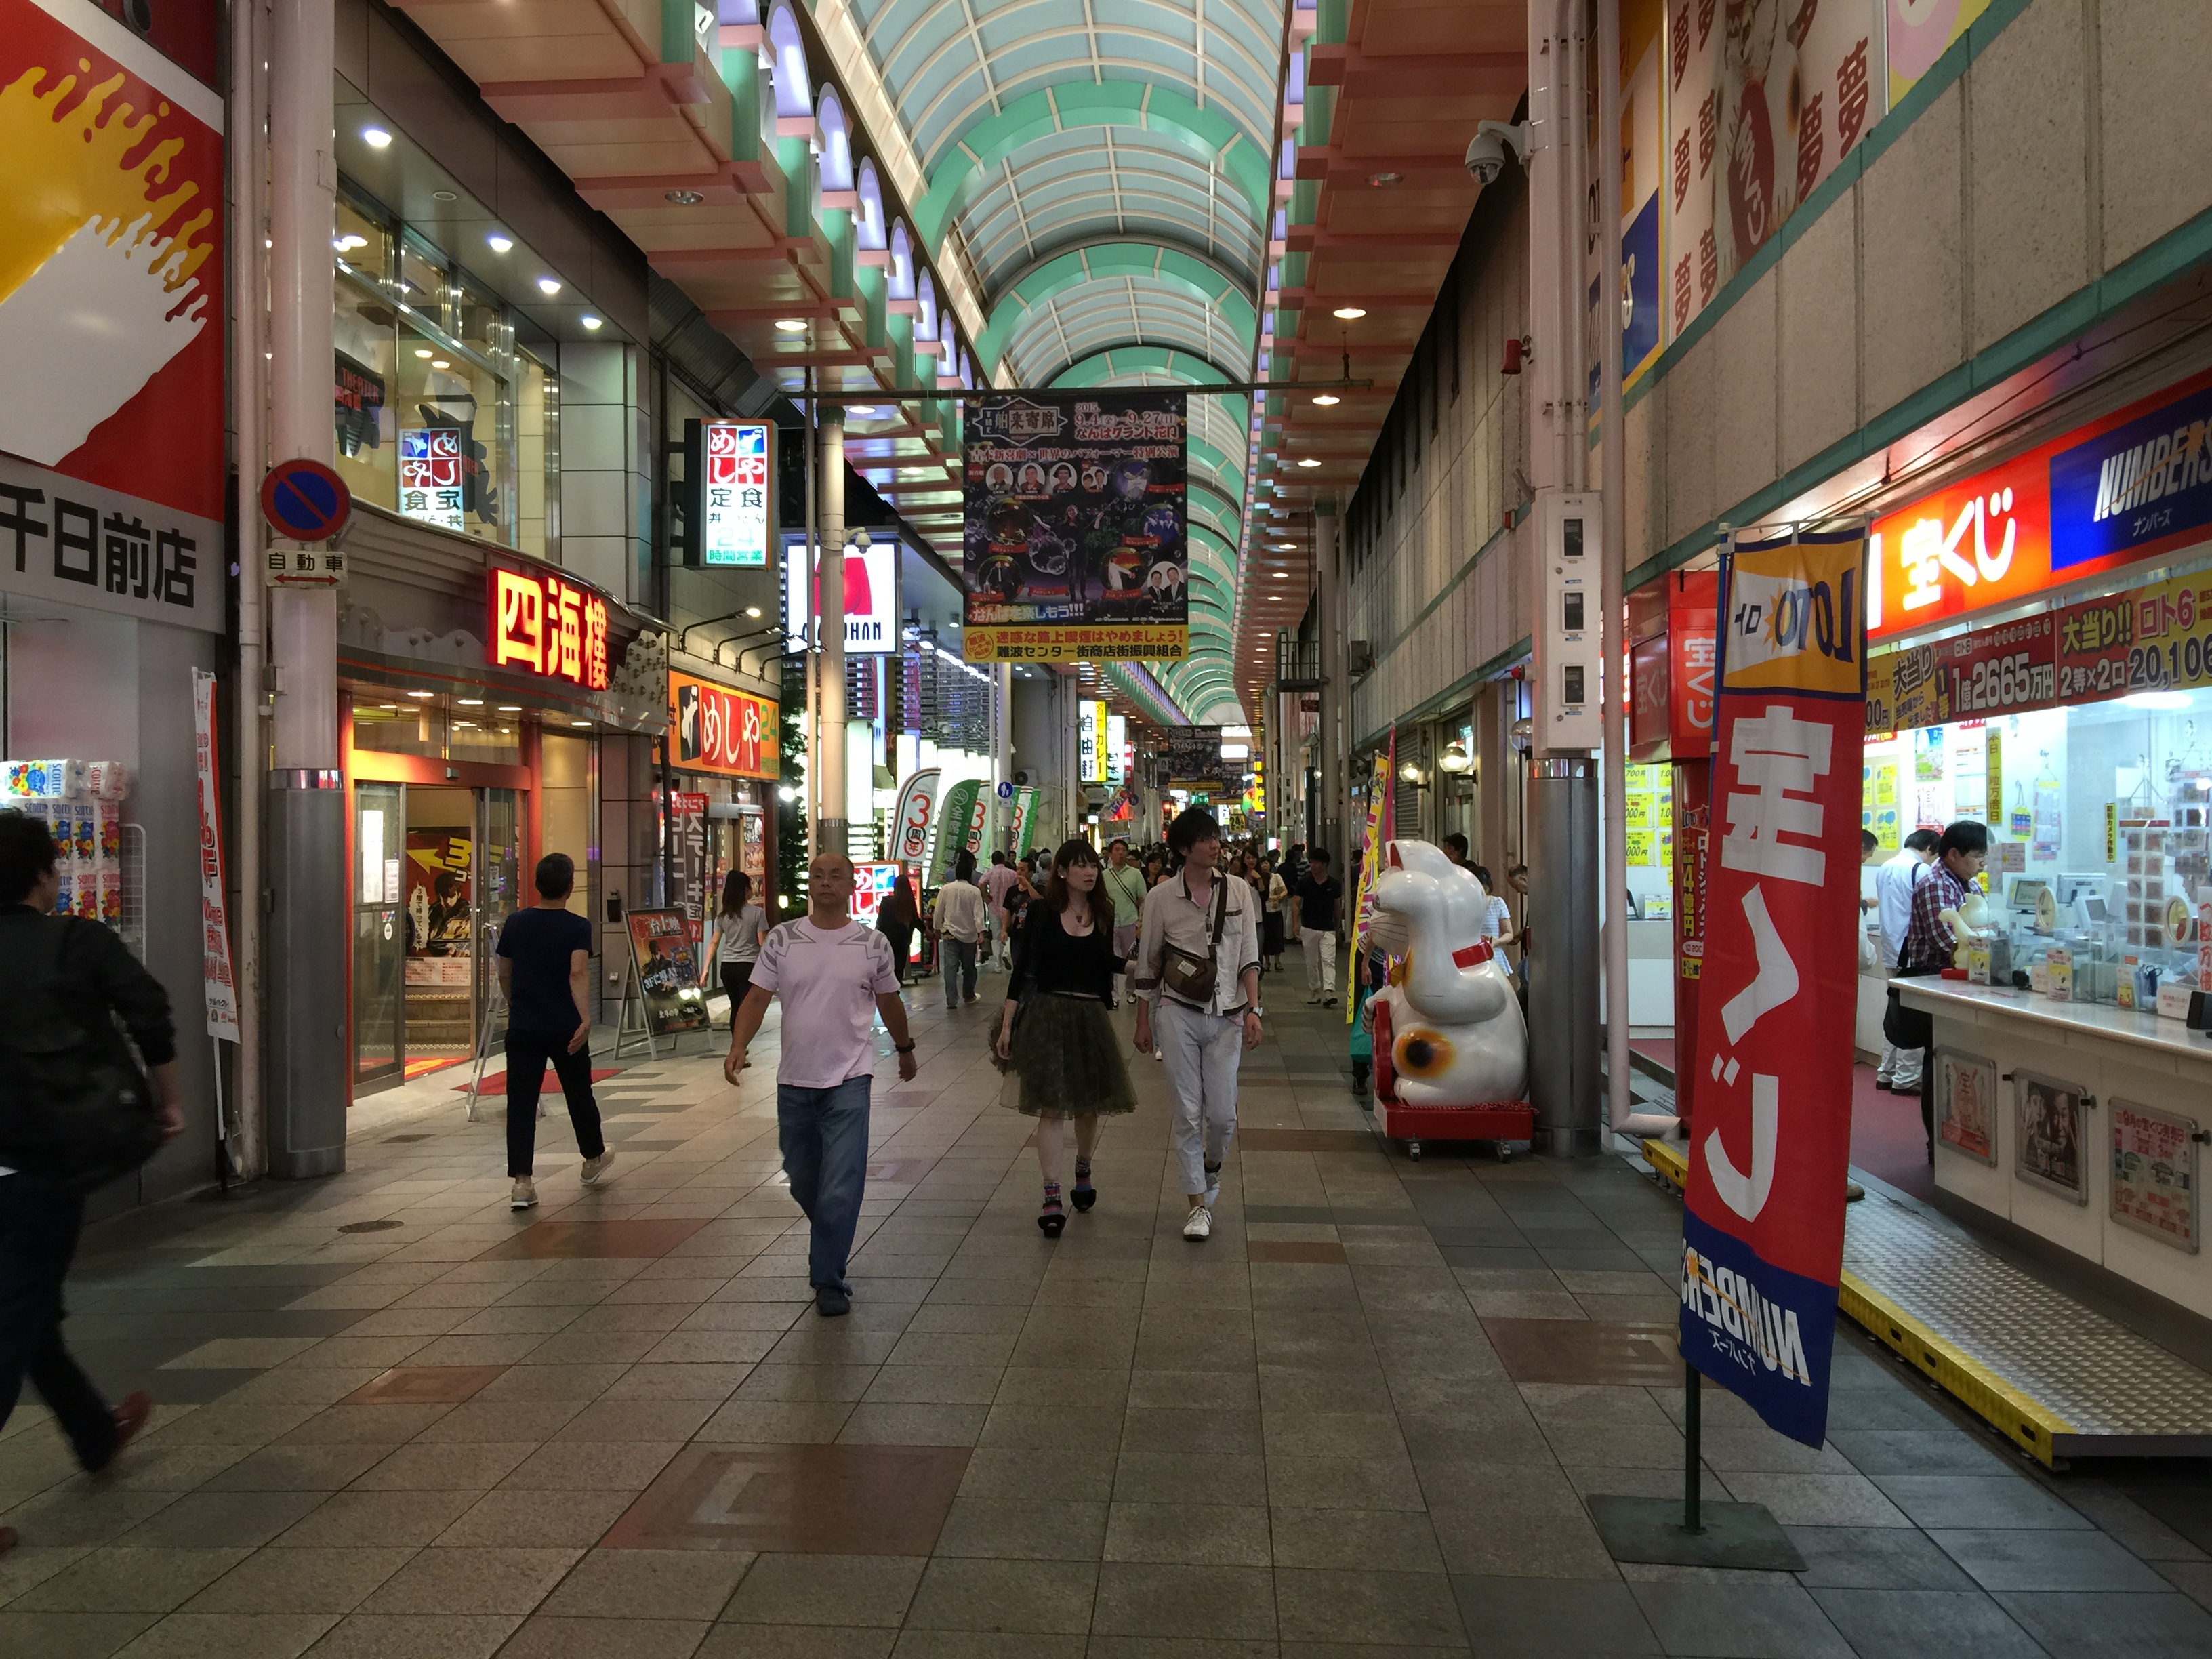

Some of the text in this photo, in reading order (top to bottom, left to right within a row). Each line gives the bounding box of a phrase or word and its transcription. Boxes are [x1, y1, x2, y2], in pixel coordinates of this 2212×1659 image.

[994, 411, 1055, 430] 舶来寄席
[2093, 418, 2212, 523] NUMBERS
[710, 487, 763, 508] 定食
[0, 480, 197, 609] 千日前店
[2133, 510, 2173, 537] ナンバーズ
[268, 552, 344, 572] 自動車
[708, 550, 764, 562] 時間営業
[1901, 487, 2016, 611] 宝くじ
[2062, 600, 2132, 655] 大当り!!
[2139, 589, 2195, 639] ロト6
[996, 644, 1183, 658] 難波センター街商店街振興組合
[1952, 652, 2055, 714] 1億2665万円
[1095, 703, 1105, 775] 名物カレー
